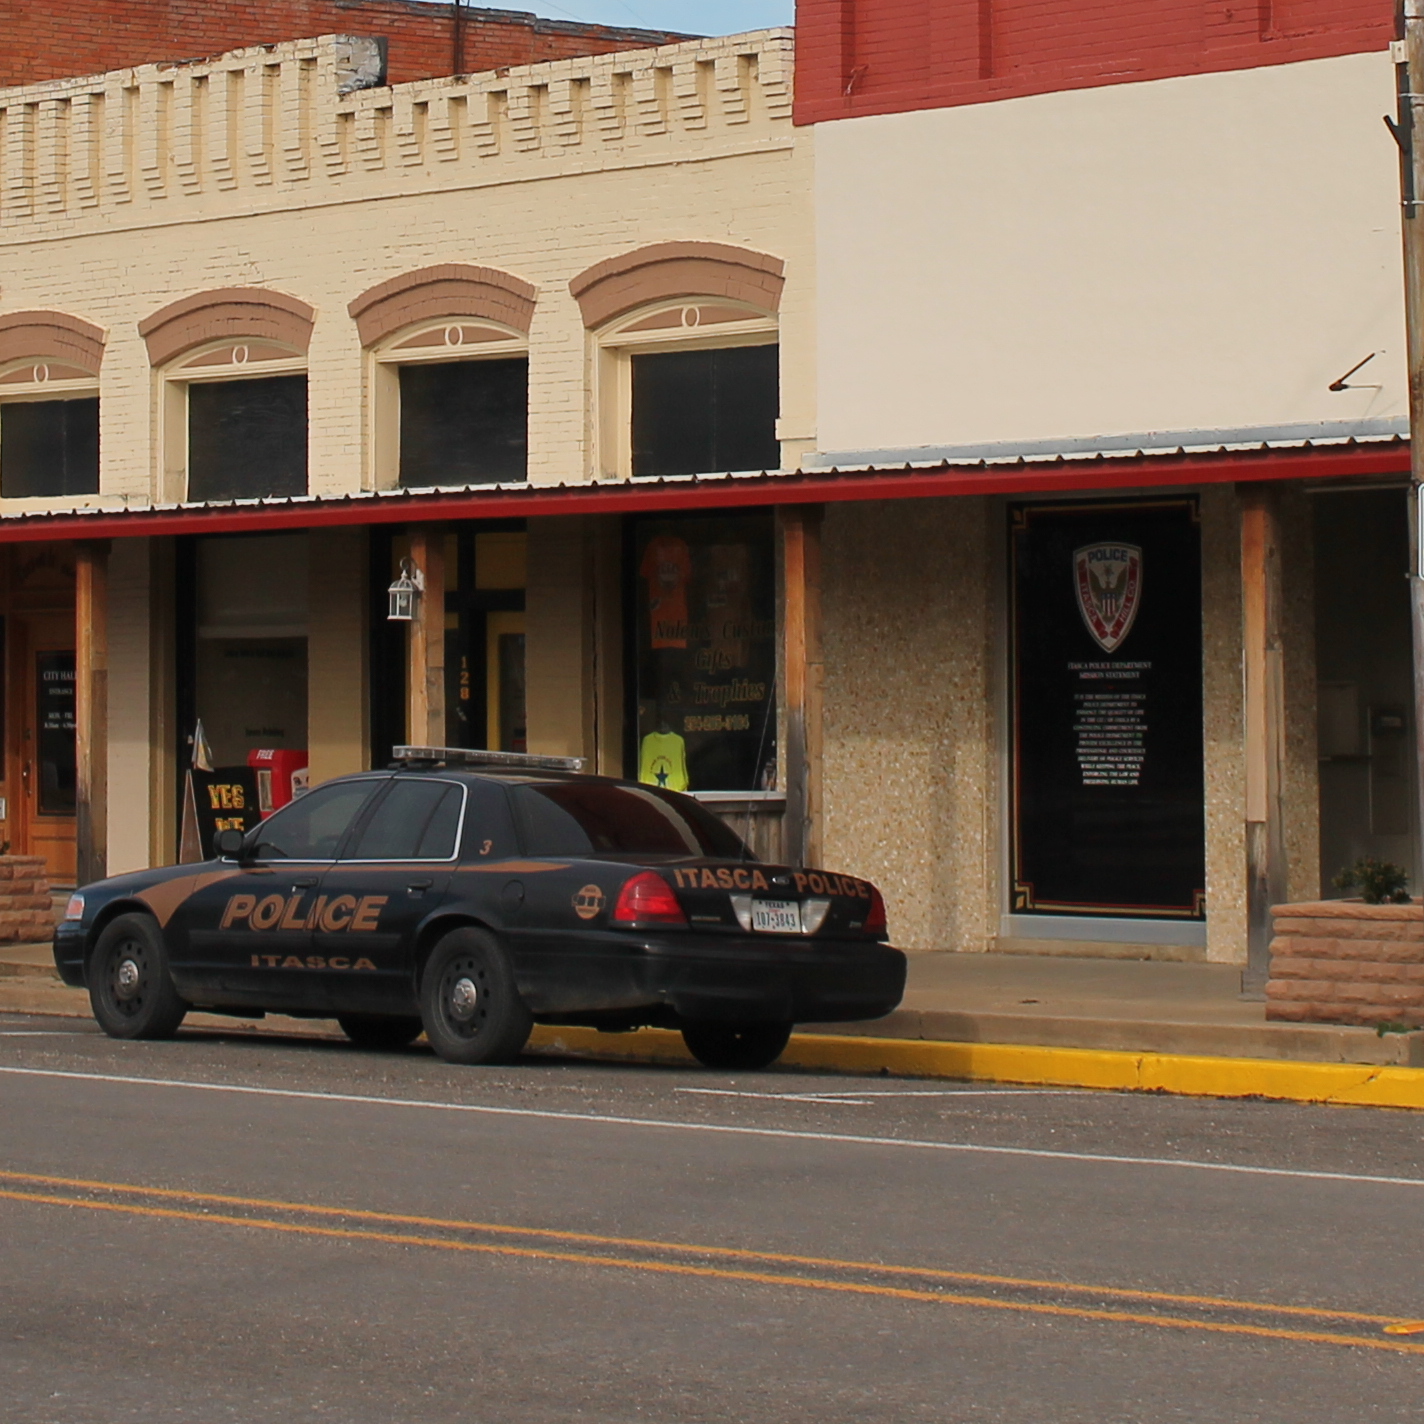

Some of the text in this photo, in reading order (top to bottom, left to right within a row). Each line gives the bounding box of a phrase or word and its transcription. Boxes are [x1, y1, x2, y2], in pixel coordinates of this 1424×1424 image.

[1087, 548, 1128, 564] POLICE
[693, 678, 766, 708] Trophies
[256, 749, 274, 760] FREE
[207, 784, 244, 809] YES
[479, 839, 493, 855] 3
[673, 868, 871, 899] ITASCA POLICE
[219, 894, 389, 932] POLICE
[251, 955, 378, 971] ITASCA
